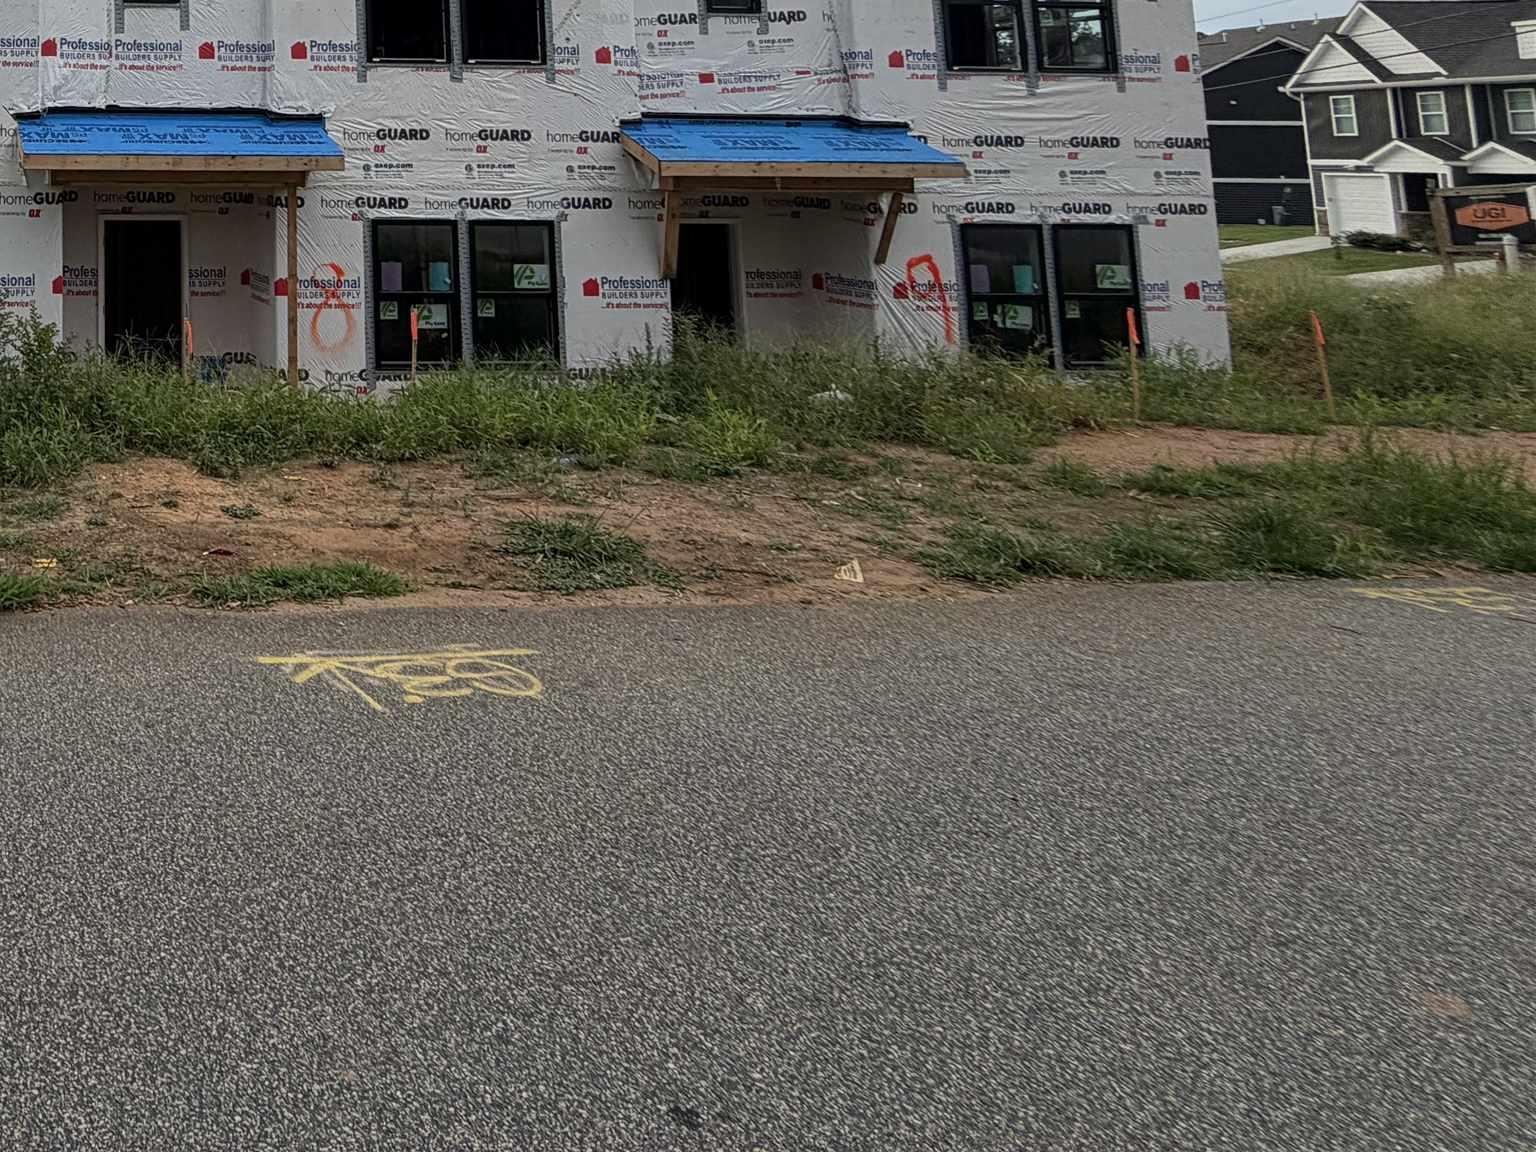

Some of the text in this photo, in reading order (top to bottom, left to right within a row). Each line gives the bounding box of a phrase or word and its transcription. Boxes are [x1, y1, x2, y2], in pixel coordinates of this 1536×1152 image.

[115, 39, 182, 51] Professional
[343, 128, 430, 142] homeGUARD
[445, 129, 532, 142] homeGUARD
[942, 136, 1024, 148] homeGUARD
[1039, 136, 1120, 148] homeGUARD
[1134, 137, 1212, 149] homeGUARD
[94, 192, 175, 204] homeGUARD
[424, 198, 511, 210] homeGUARD
[526, 197, 612, 210] homeGUARD
[932, 202, 1015, 215] homeGUARD
[601, 276, 668, 288] Professional
